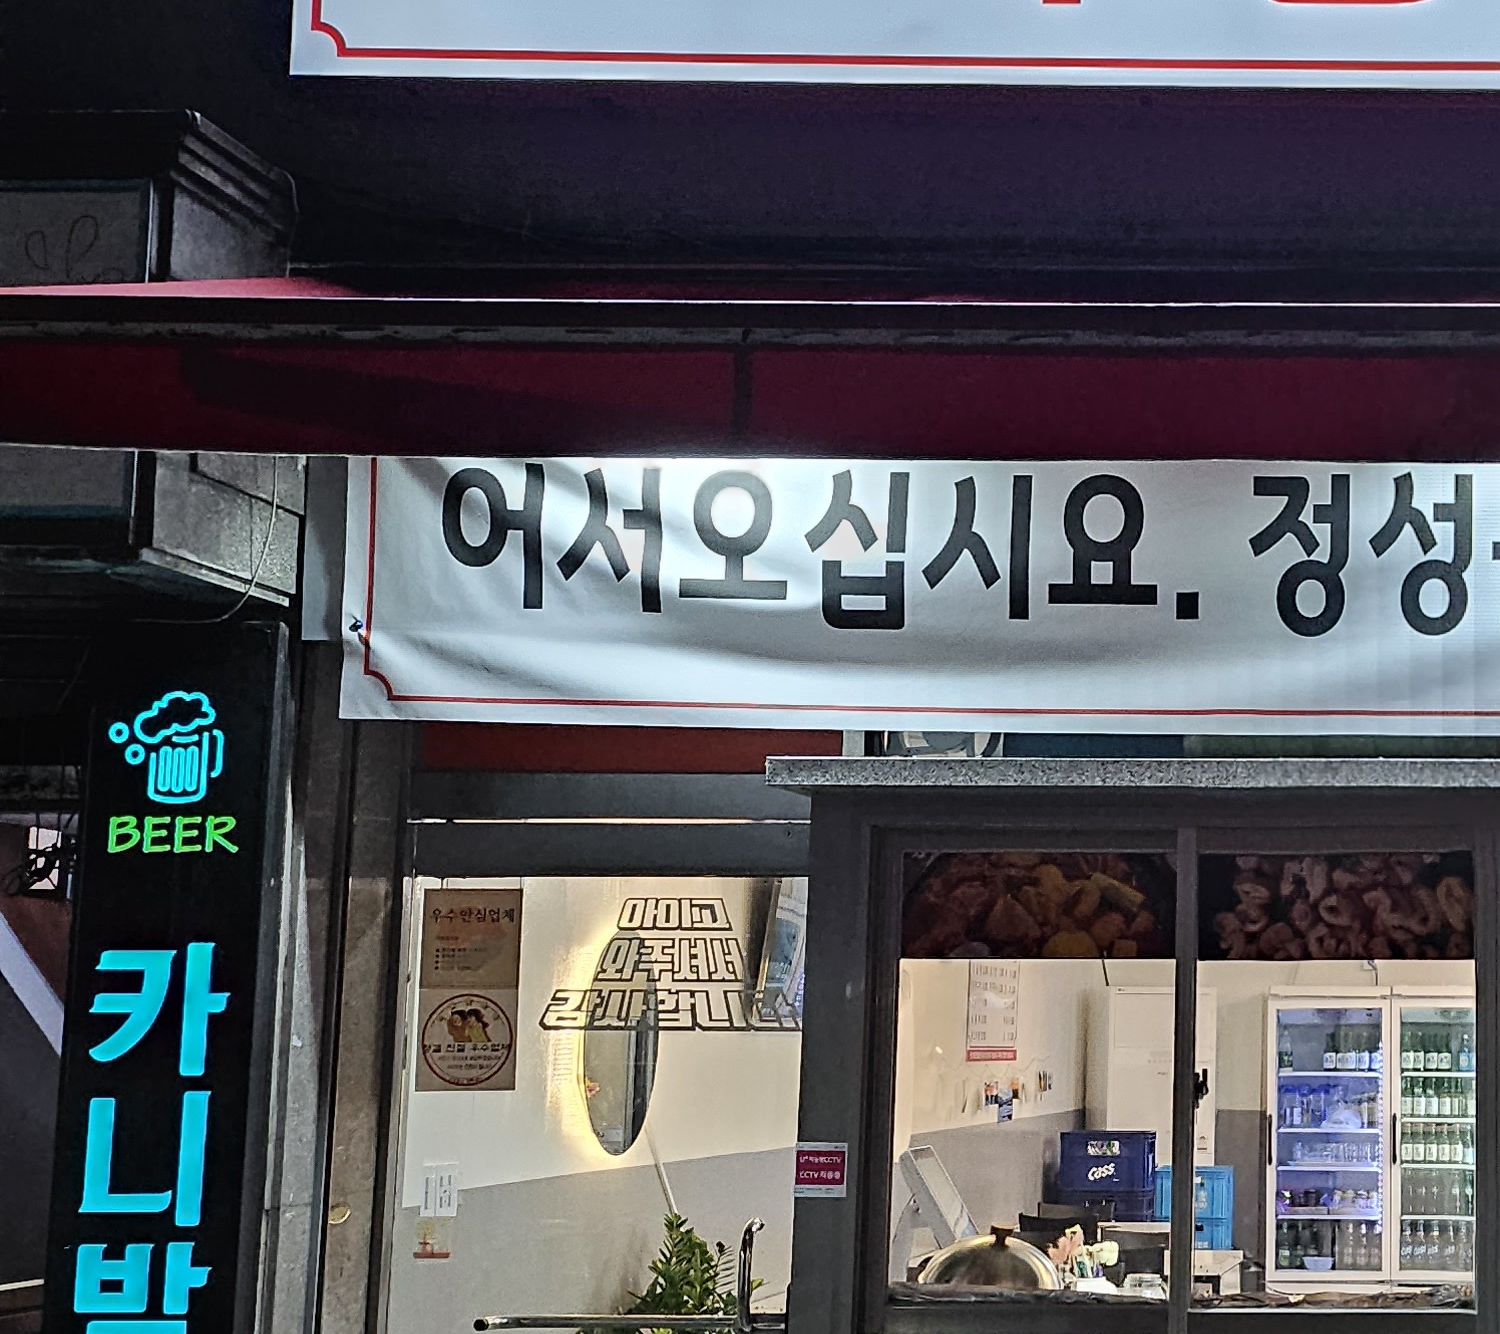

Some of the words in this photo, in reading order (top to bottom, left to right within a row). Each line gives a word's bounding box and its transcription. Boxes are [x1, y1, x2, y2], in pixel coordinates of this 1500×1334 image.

[441, 462, 1201, 631] 어서오십시요.
[106, 816, 239, 854] BEER
[617, 898, 733, 931] 아이고
[595, 938, 749, 983] 와주셔서
